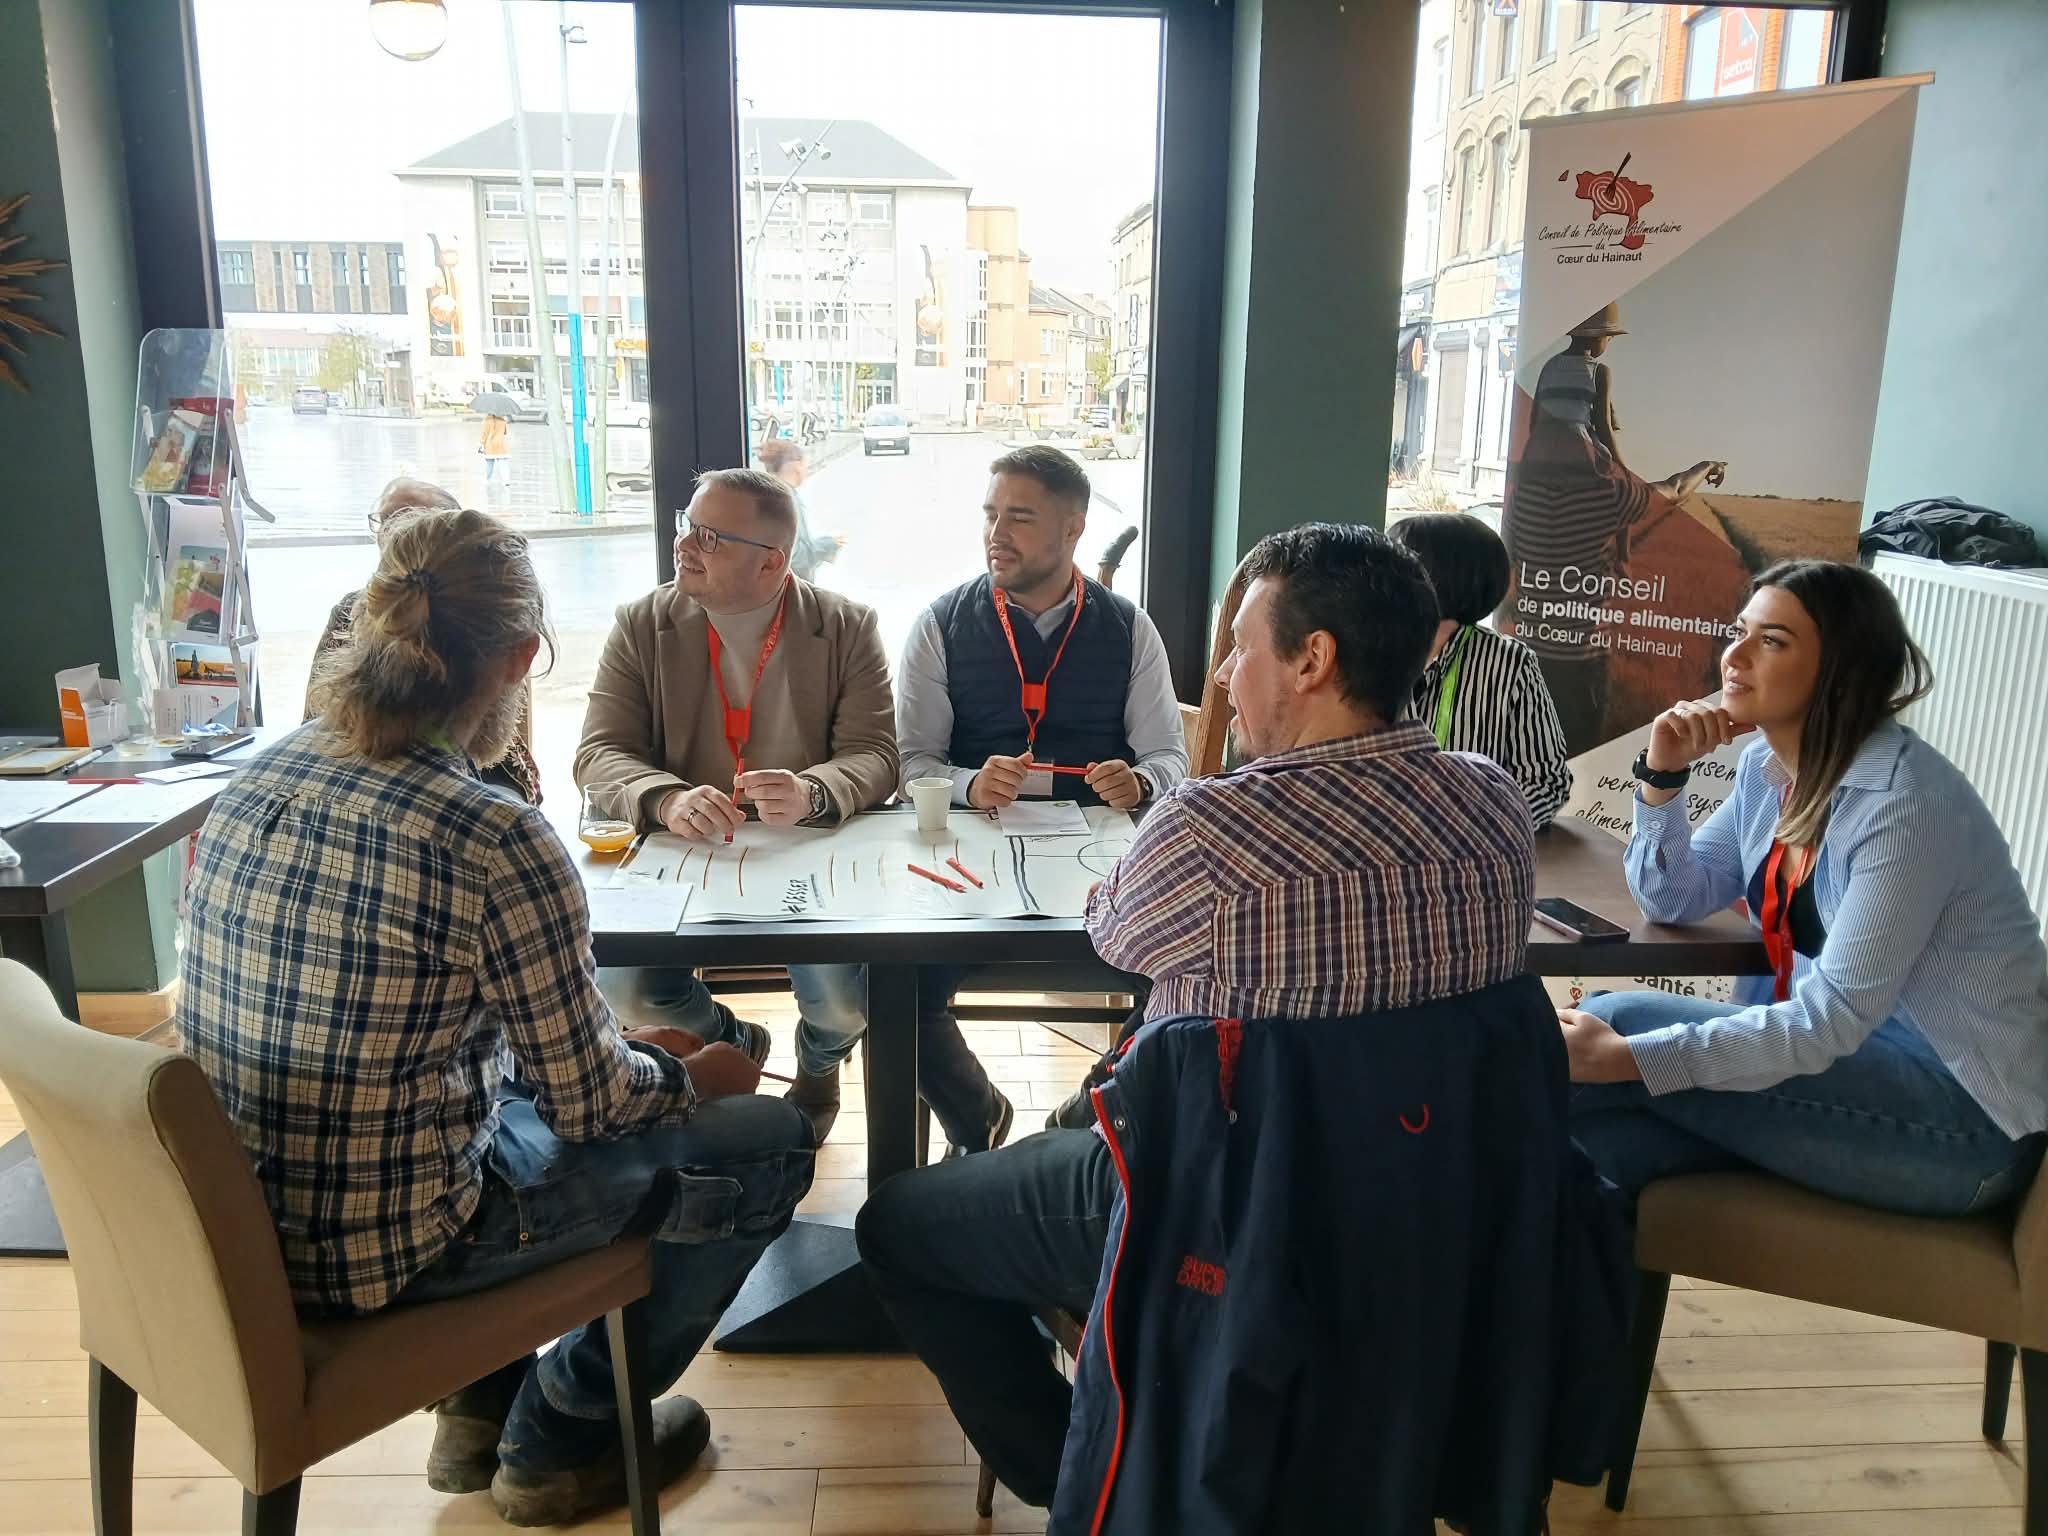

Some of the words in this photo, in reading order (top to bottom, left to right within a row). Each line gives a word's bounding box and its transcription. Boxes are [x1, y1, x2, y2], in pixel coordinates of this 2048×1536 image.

[1538, 225, 1571, 241] Conseil
[1571, 225, 1580, 238] de
[1584, 222, 1623, 241] Politique
[1625, 220, 1682, 235] Alimentaire
[1595, 239, 1605, 250] du
[1557, 254, 1583, 264] Cœur
[1586, 253, 1599, 263] du
[1601, 251, 1642, 263] Hainaut
[1520, 561, 1550, 590] Le
[1559, 565, 1666, 602] Conseil
[1517, 596, 1538, 614] de
[1542, 600, 1625, 626] politique
[1630, 610, 1738, 639] alimentaire
[1515, 621, 1533, 638] du
[1538, 623, 1585, 644] Cœur
[1589, 631, 1612, 648] du
[1617, 633, 1683, 658] Hainaut
